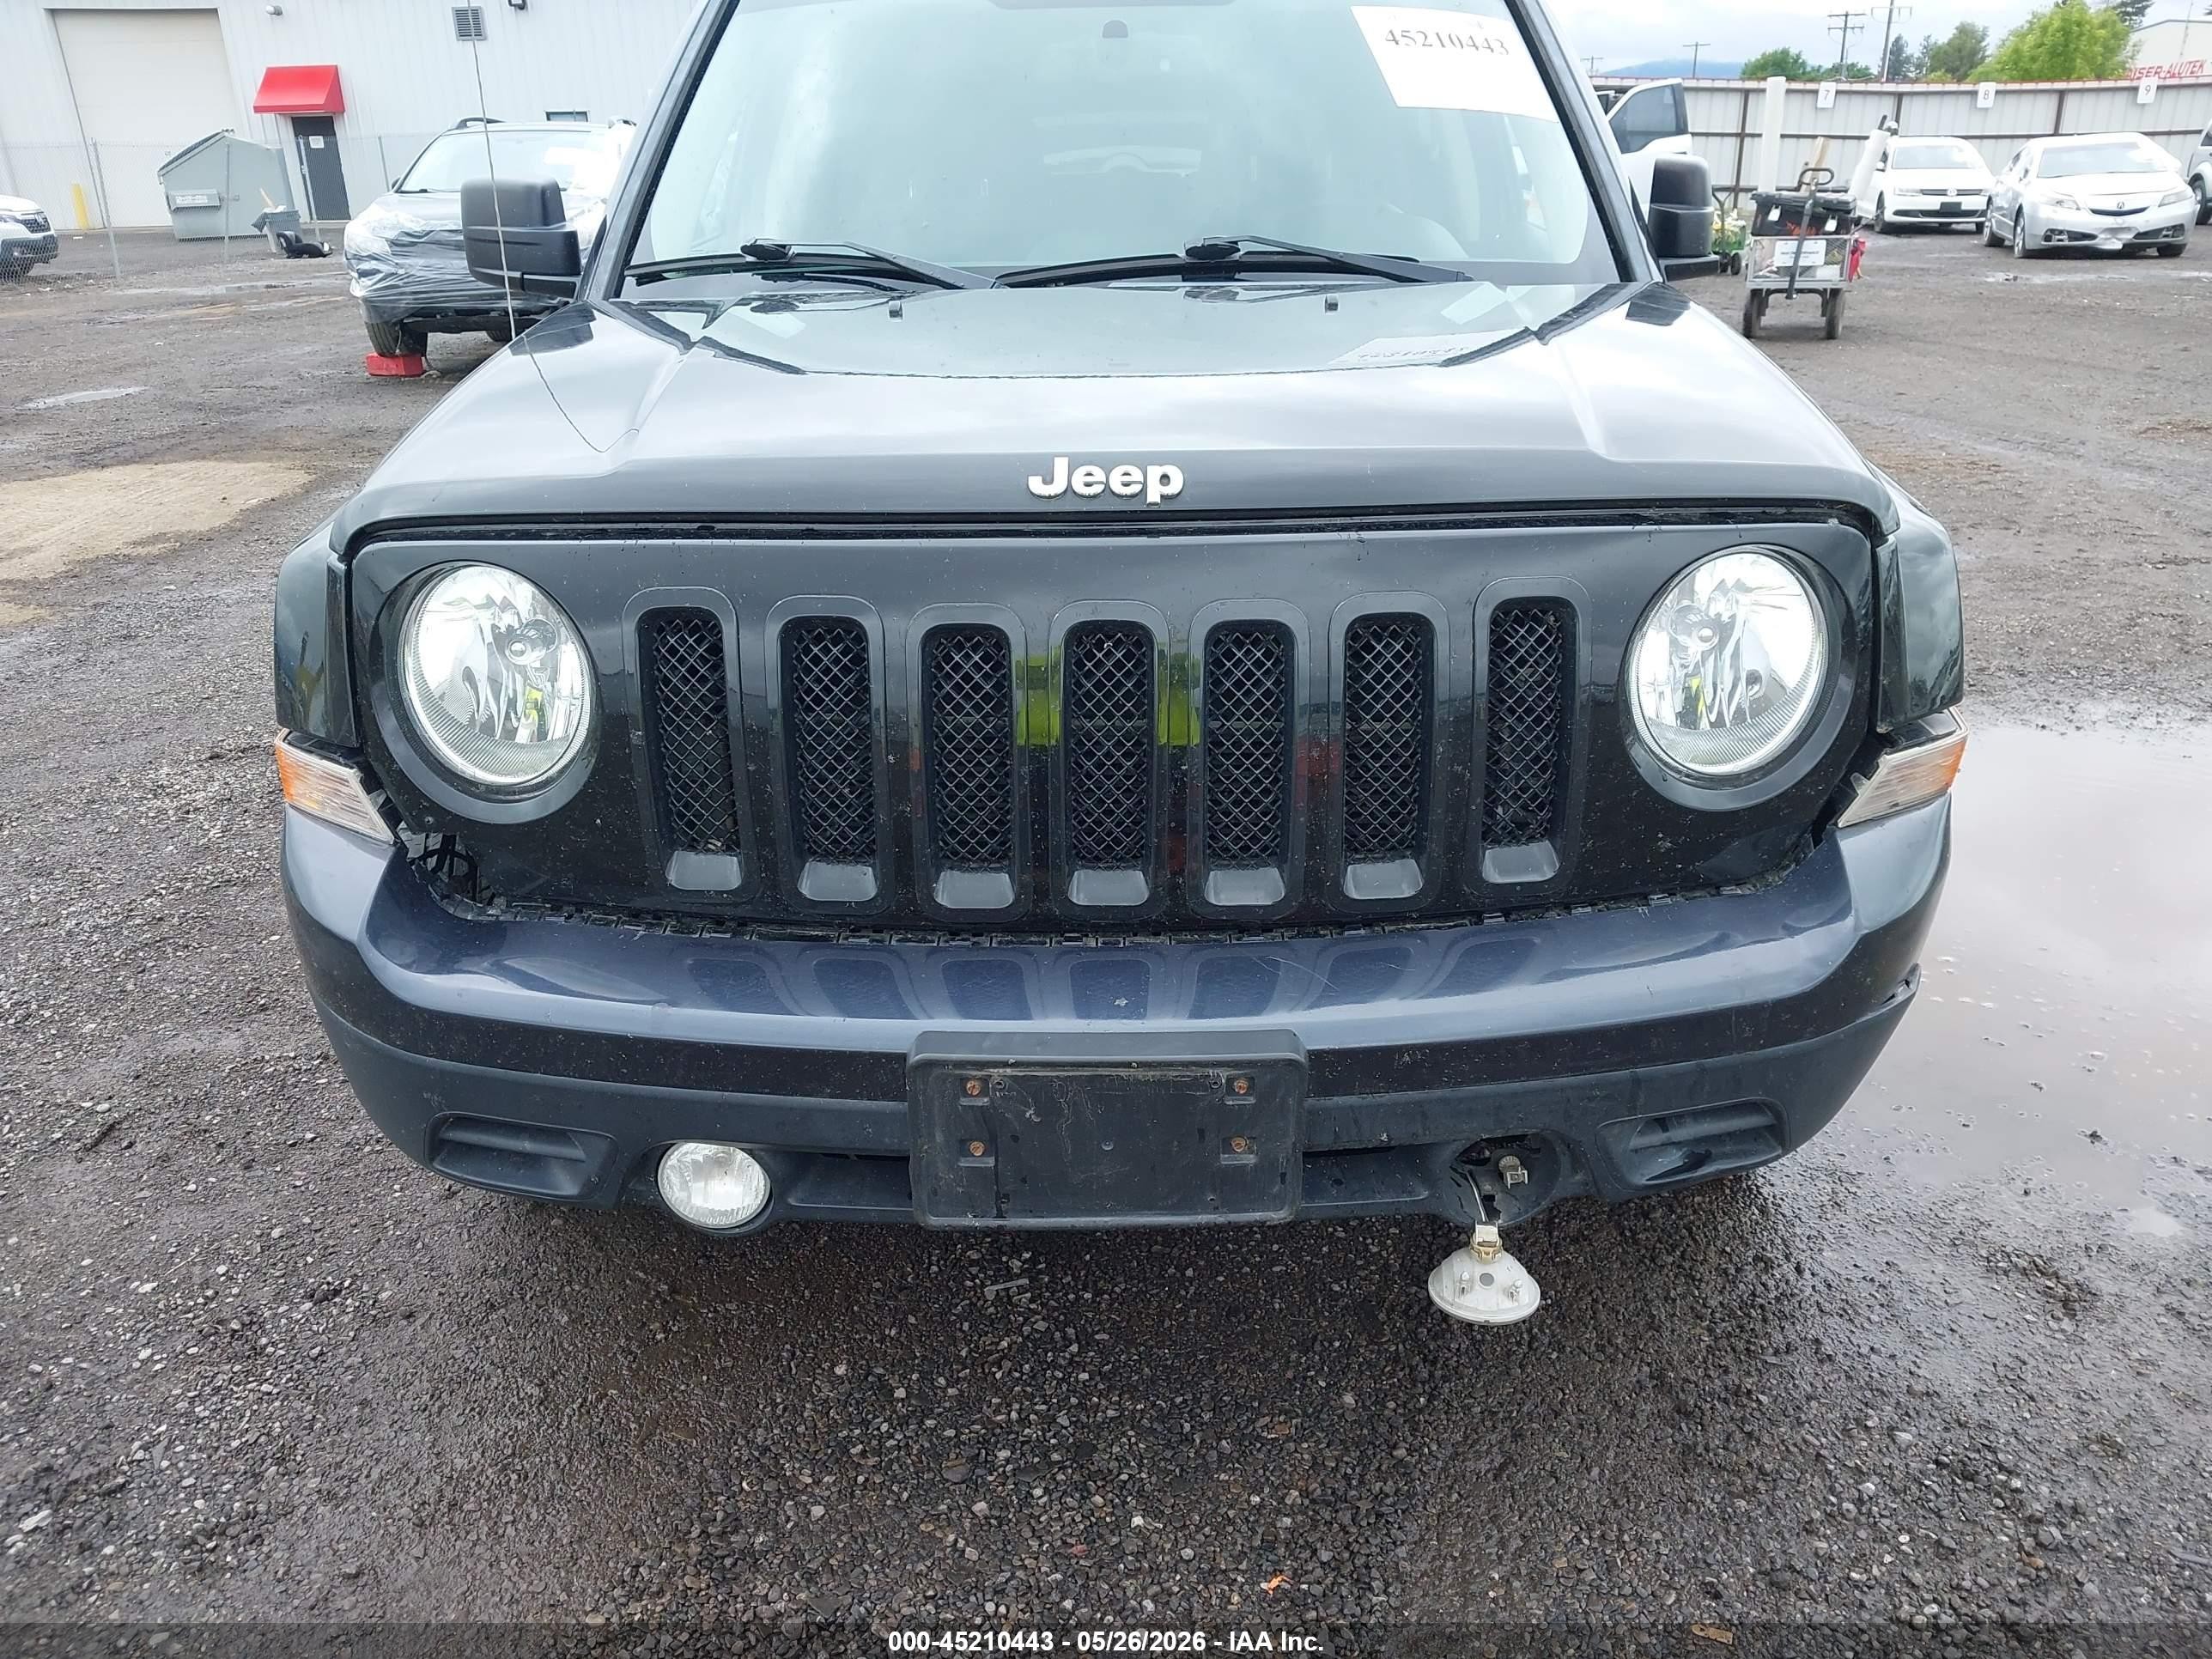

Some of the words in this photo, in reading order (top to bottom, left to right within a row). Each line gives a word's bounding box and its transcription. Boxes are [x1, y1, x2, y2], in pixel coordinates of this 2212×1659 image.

[1384, 29, 1509, 55] 45210443
[1823, 89, 1831, 100] 7
[1983, 88, 1990, 100] 8
[2143, 84, 2152, 95] 9
[1027, 456, 1184, 508] Jeep
